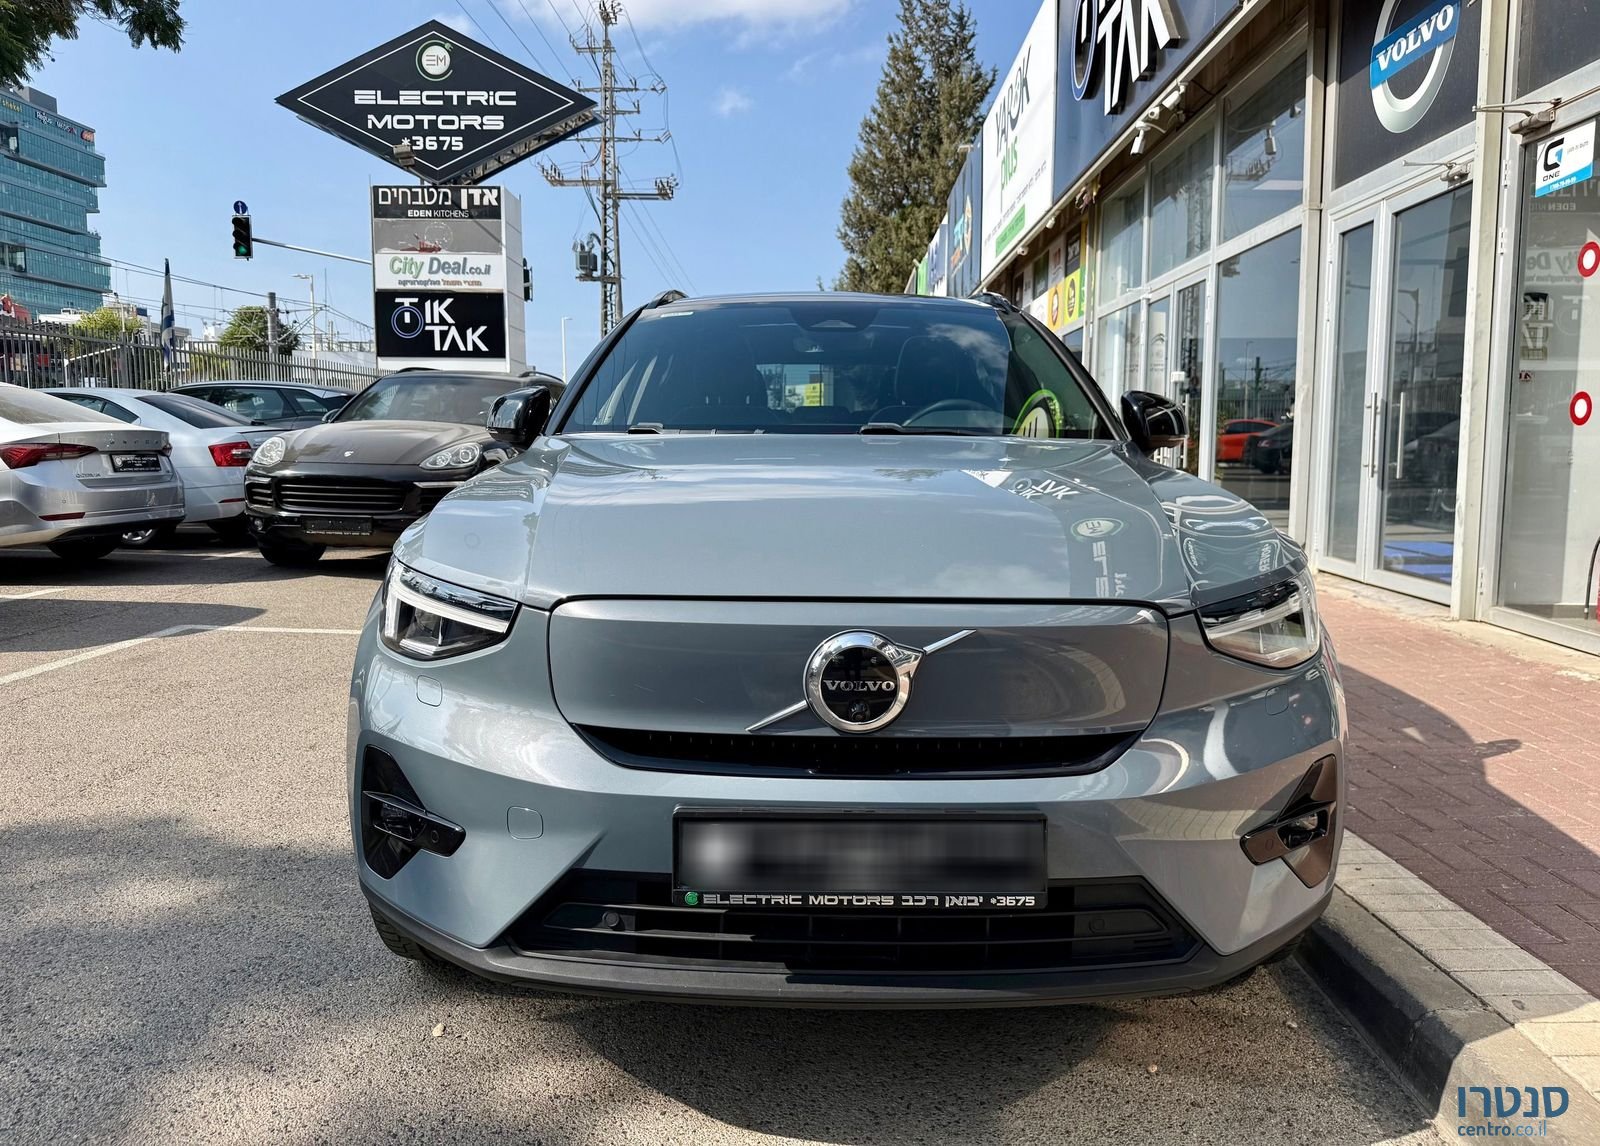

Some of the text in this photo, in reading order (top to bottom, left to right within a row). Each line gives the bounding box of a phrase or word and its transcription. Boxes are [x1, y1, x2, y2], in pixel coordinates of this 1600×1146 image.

[1376, 4, 1454, 71] VOLVO
[354, 90, 517, 106] ELECTRIC
[996, 45, 1031, 157] YAROK
[367, 114, 505, 130] MOTORS
[1001, 136, 1018, 213] plus
[378, 187, 499, 210] אדן מטבחים
[407, 209, 469, 218] EDEN KITCHENS
[389, 255, 491, 279] City Deal.co.il
[425, 325, 489, 352] TAK
[823, 679, 896, 692] VOLVO
[703, 893, 802, 905] ELECTRIC
[809, 894, 894, 906] MOTORS
[901, 895, 939, 906] רכב
[945, 895, 984, 908] יבואן
